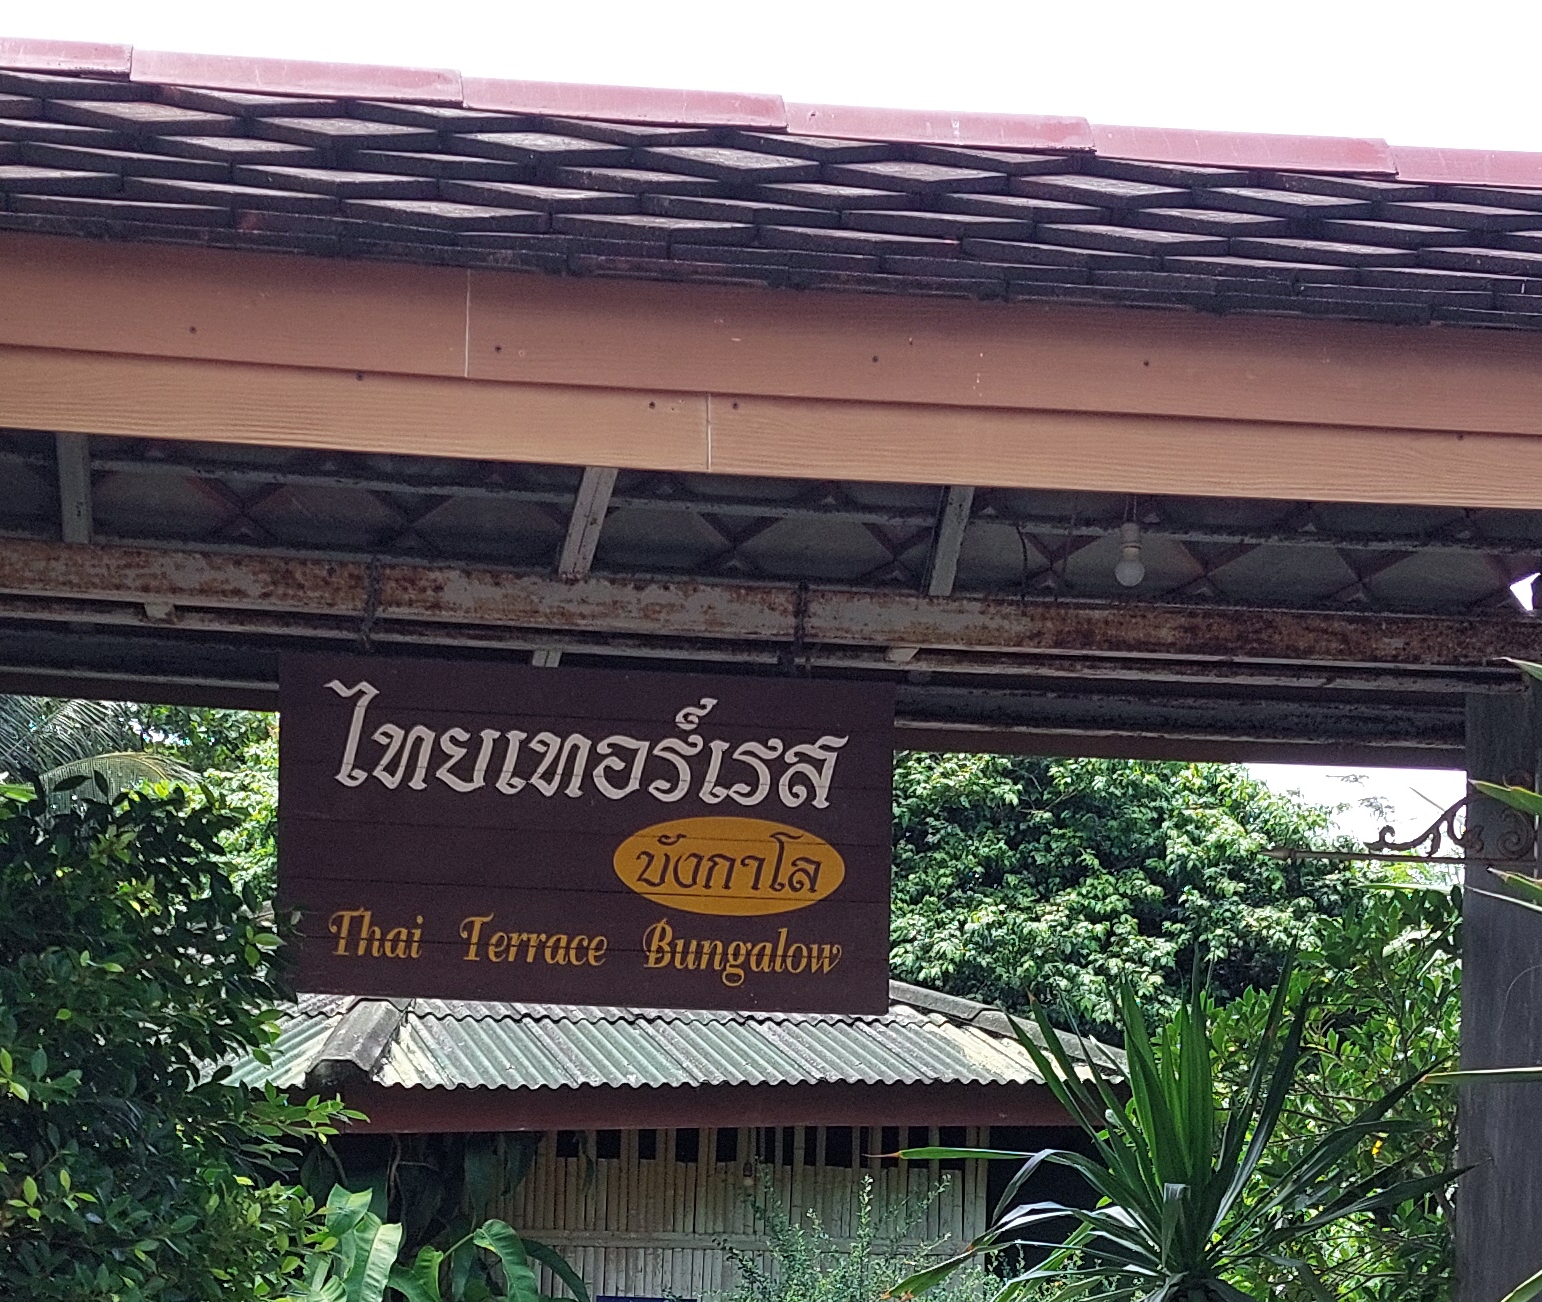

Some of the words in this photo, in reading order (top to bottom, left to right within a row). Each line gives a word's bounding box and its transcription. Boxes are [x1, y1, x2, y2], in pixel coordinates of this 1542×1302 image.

[325, 680, 848, 808] ไทยเทอร์เรส
[635, 832, 820, 893] บังกาโล
[328, 907, 423, 959] Thai
[460, 914, 607, 966] Terrace
[643, 918, 842, 987] Bungalow
